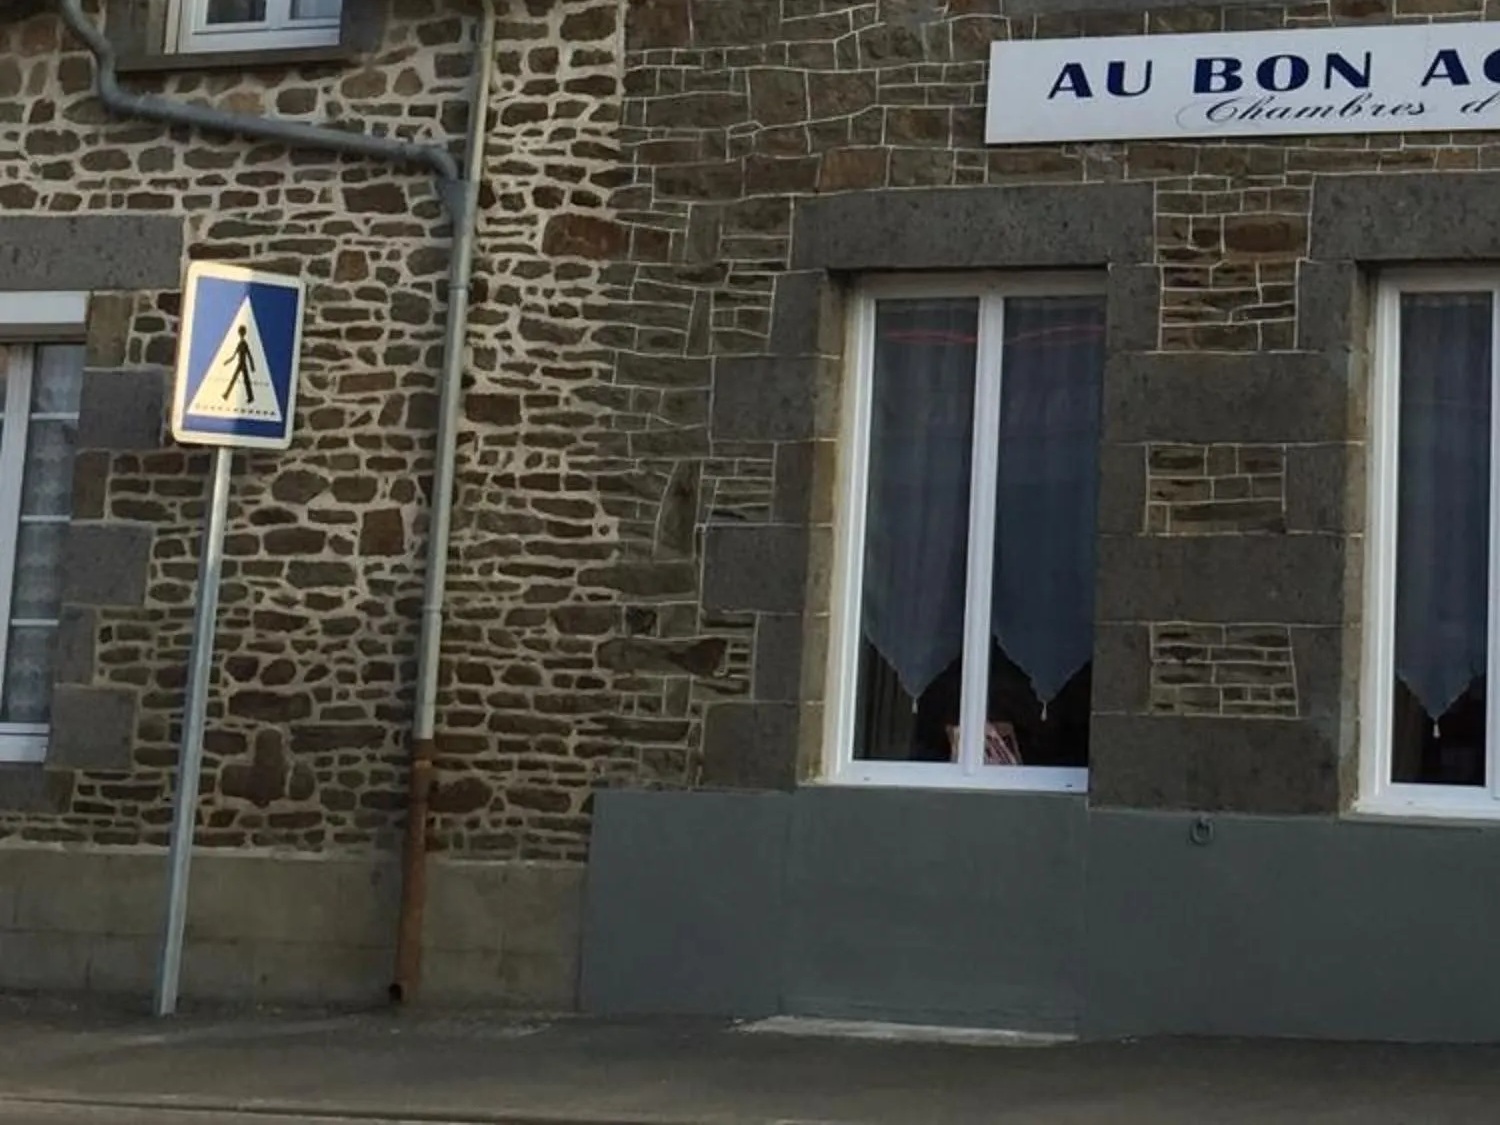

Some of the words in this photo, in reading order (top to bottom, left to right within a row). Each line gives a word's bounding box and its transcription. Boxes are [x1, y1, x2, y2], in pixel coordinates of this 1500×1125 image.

[1048, 60, 1152, 100] AU
[1193, 51, 1371, 94] BON
[1178, 92, 1427, 127] Chambres
